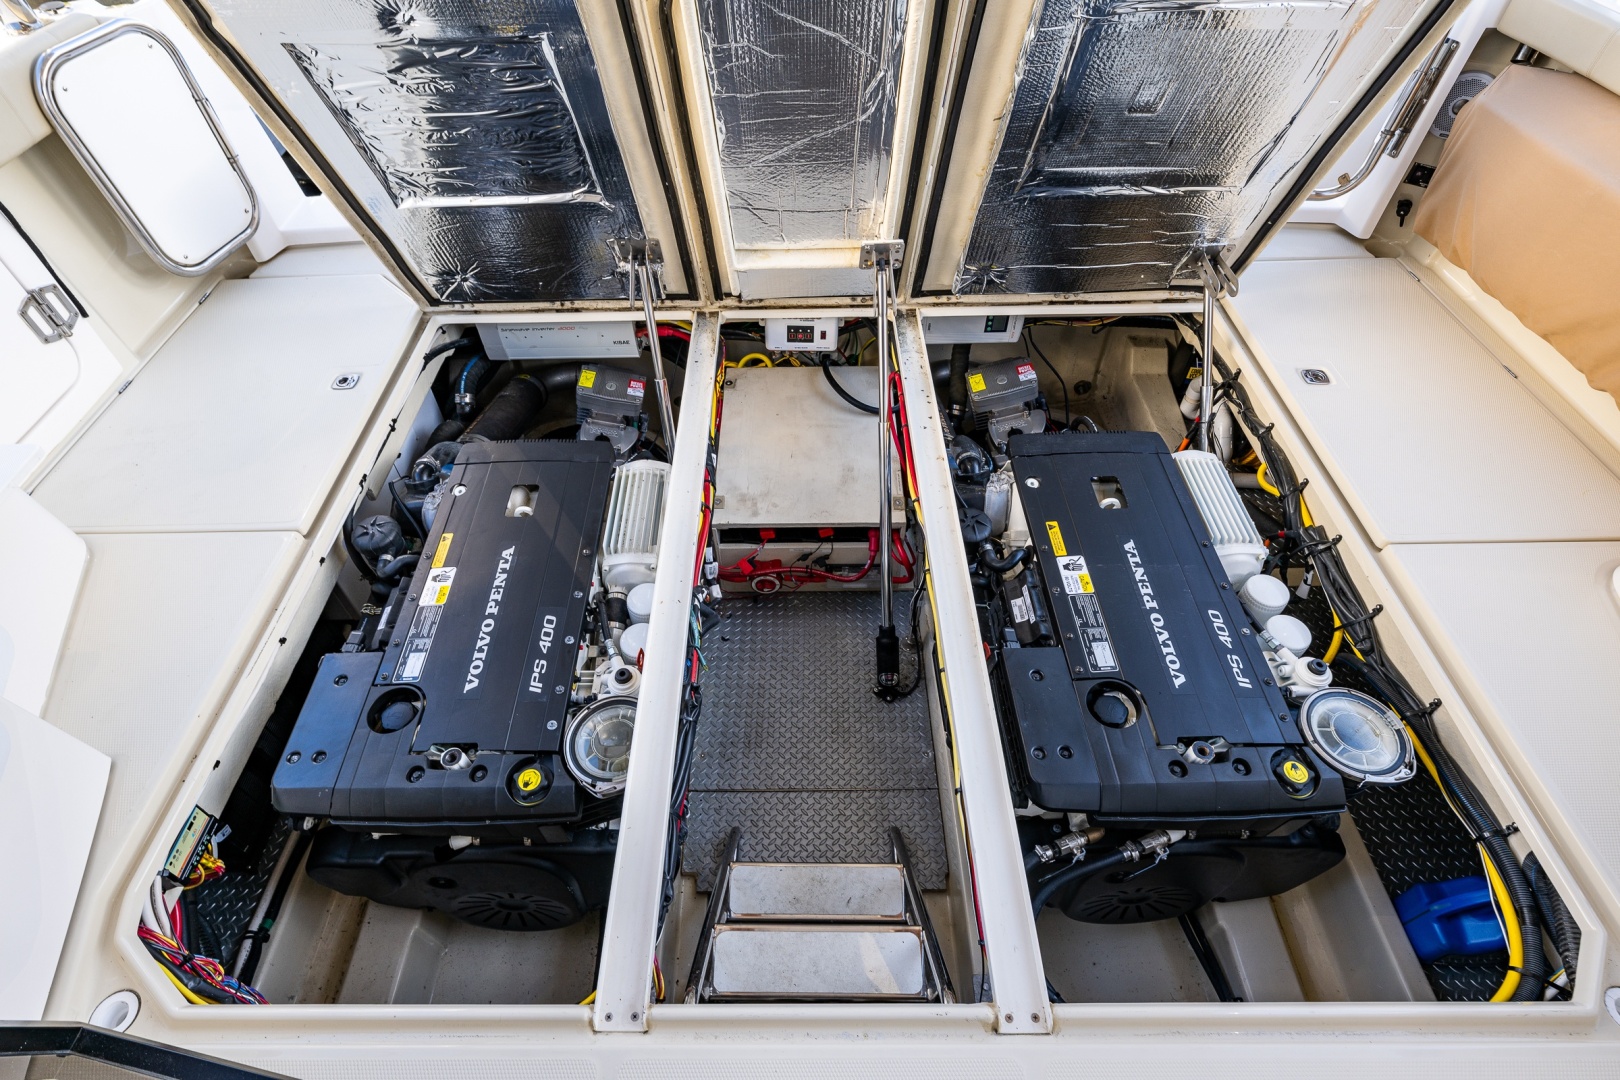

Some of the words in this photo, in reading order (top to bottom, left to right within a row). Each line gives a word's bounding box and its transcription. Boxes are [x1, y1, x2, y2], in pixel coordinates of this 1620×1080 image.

[1123, 539, 1159, 610] PENTA
[463, 618, 495, 694] VOLVO
[485, 545, 516, 616] PENTA
[528, 658, 548, 694] IPS
[539, 614, 557, 654] 400
[1149, 612, 1187, 689] VOLVO
[1207, 609, 1233, 649] 400
[1226, 654, 1253, 689] IPS
